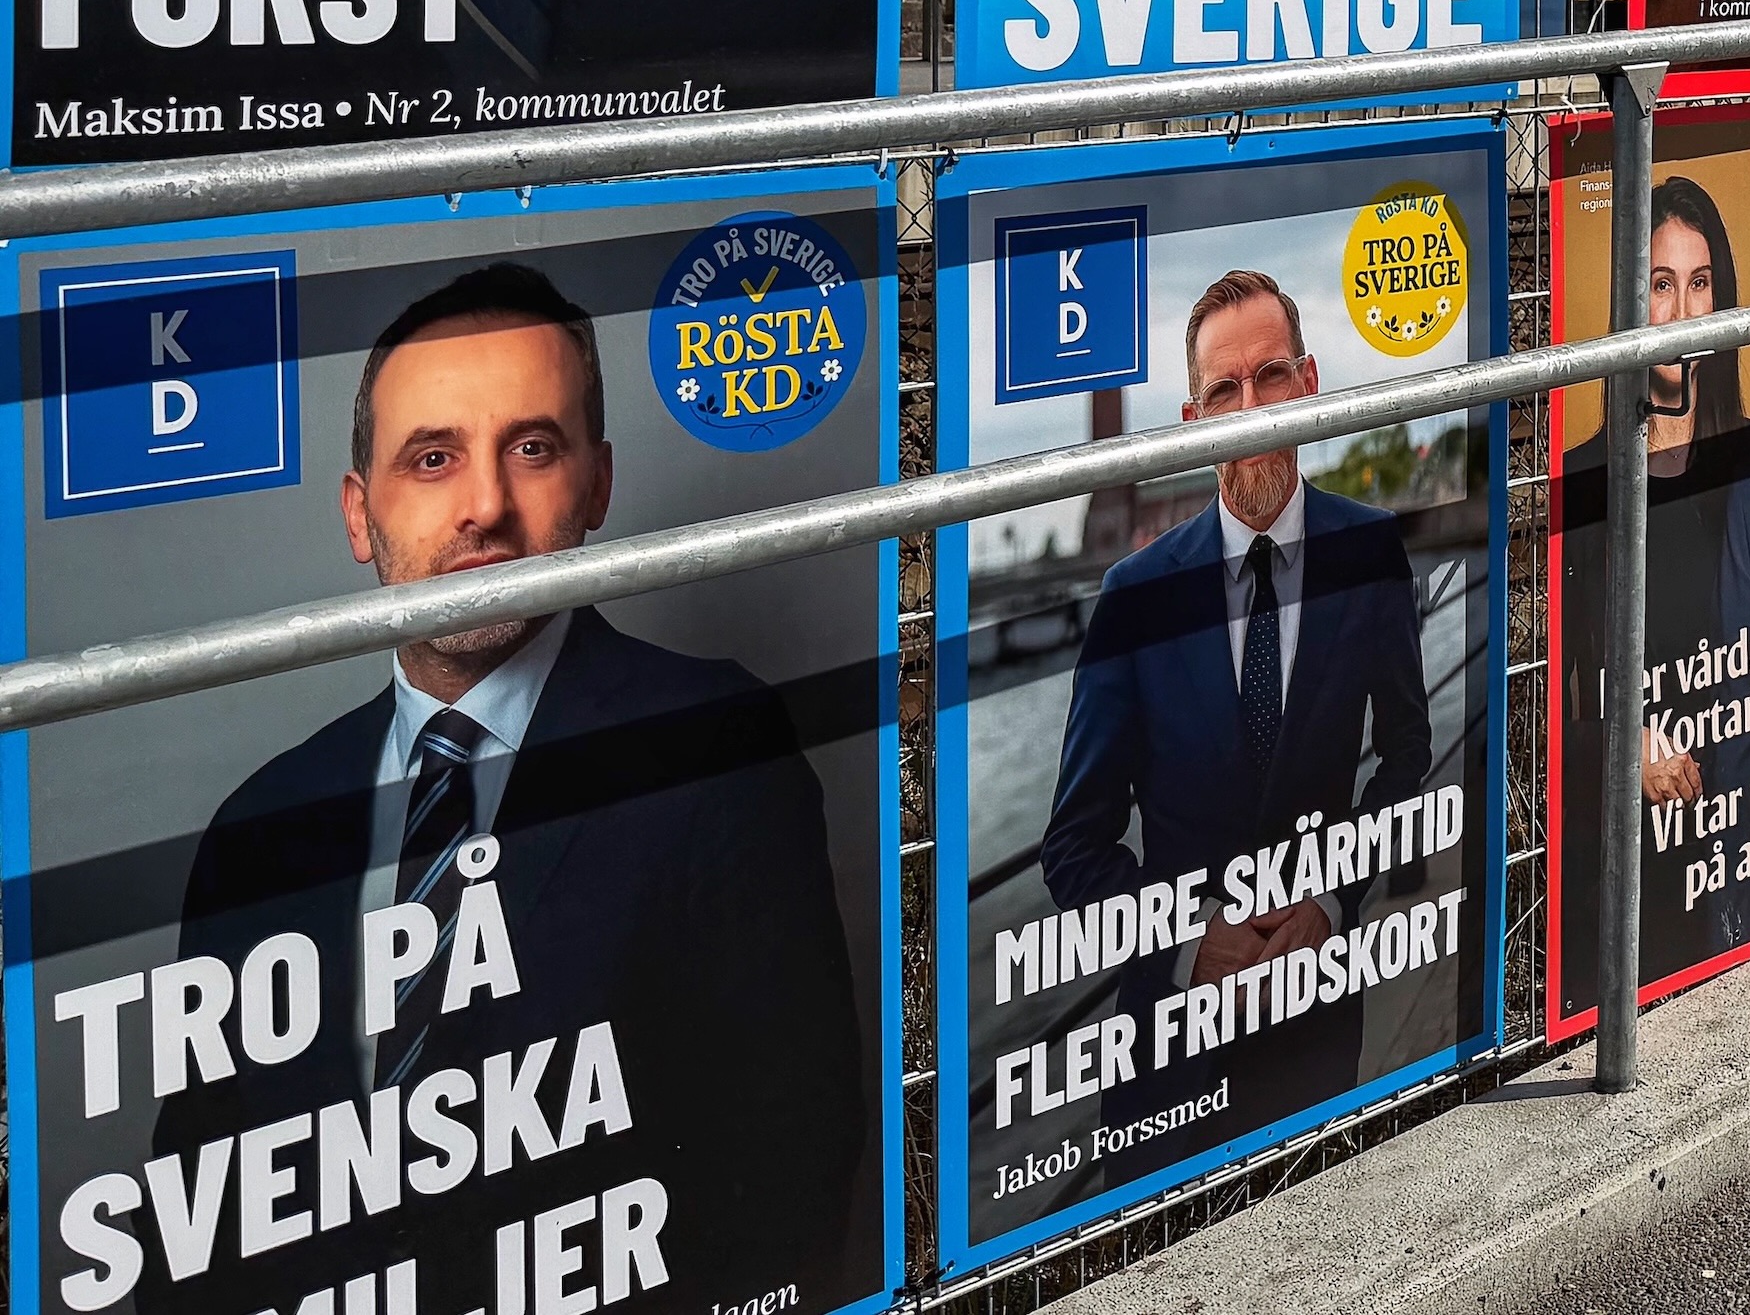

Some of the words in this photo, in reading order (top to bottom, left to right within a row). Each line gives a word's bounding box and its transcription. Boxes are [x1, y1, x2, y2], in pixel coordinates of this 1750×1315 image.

[34, 98, 225, 141] Maksim
[241, 96, 325, 132] Issa
[366, 93, 420, 127] Nr
[430, 89, 462, 132] 2,
[475, 81, 727, 123] kommunvalet
[1058, 249, 1084, 292] K
[1362, 234, 1416, 267] TRO
[1422, 224, 1453, 258] PÅ
[1354, 259, 1462, 299] SVERIGE
[150, 309, 192, 366] K
[1060, 301, 1088, 344] D
[152, 380, 198, 437] D
[722, 363, 802, 419] KD
[1651, 798, 1684, 854] Vi
[1694, 784, 1743, 839] tar
[994, 868, 1208, 1006] MINDRE
[1222, 784, 1464, 926] SKÄRMTID
[1685, 839, 1726, 912] på
[54, 931, 322, 1120] TRO
[363, 832, 522, 1038] PÅ
[995, 1014, 1137, 1130] FLER
[1154, 888, 1468, 1070] FRITIDSKORT
[58, 1020, 634, 1314] SVENSKA
[992, 1140, 1082, 1200] Jakob
[1090, 1078, 1230, 1162] Forssmed
